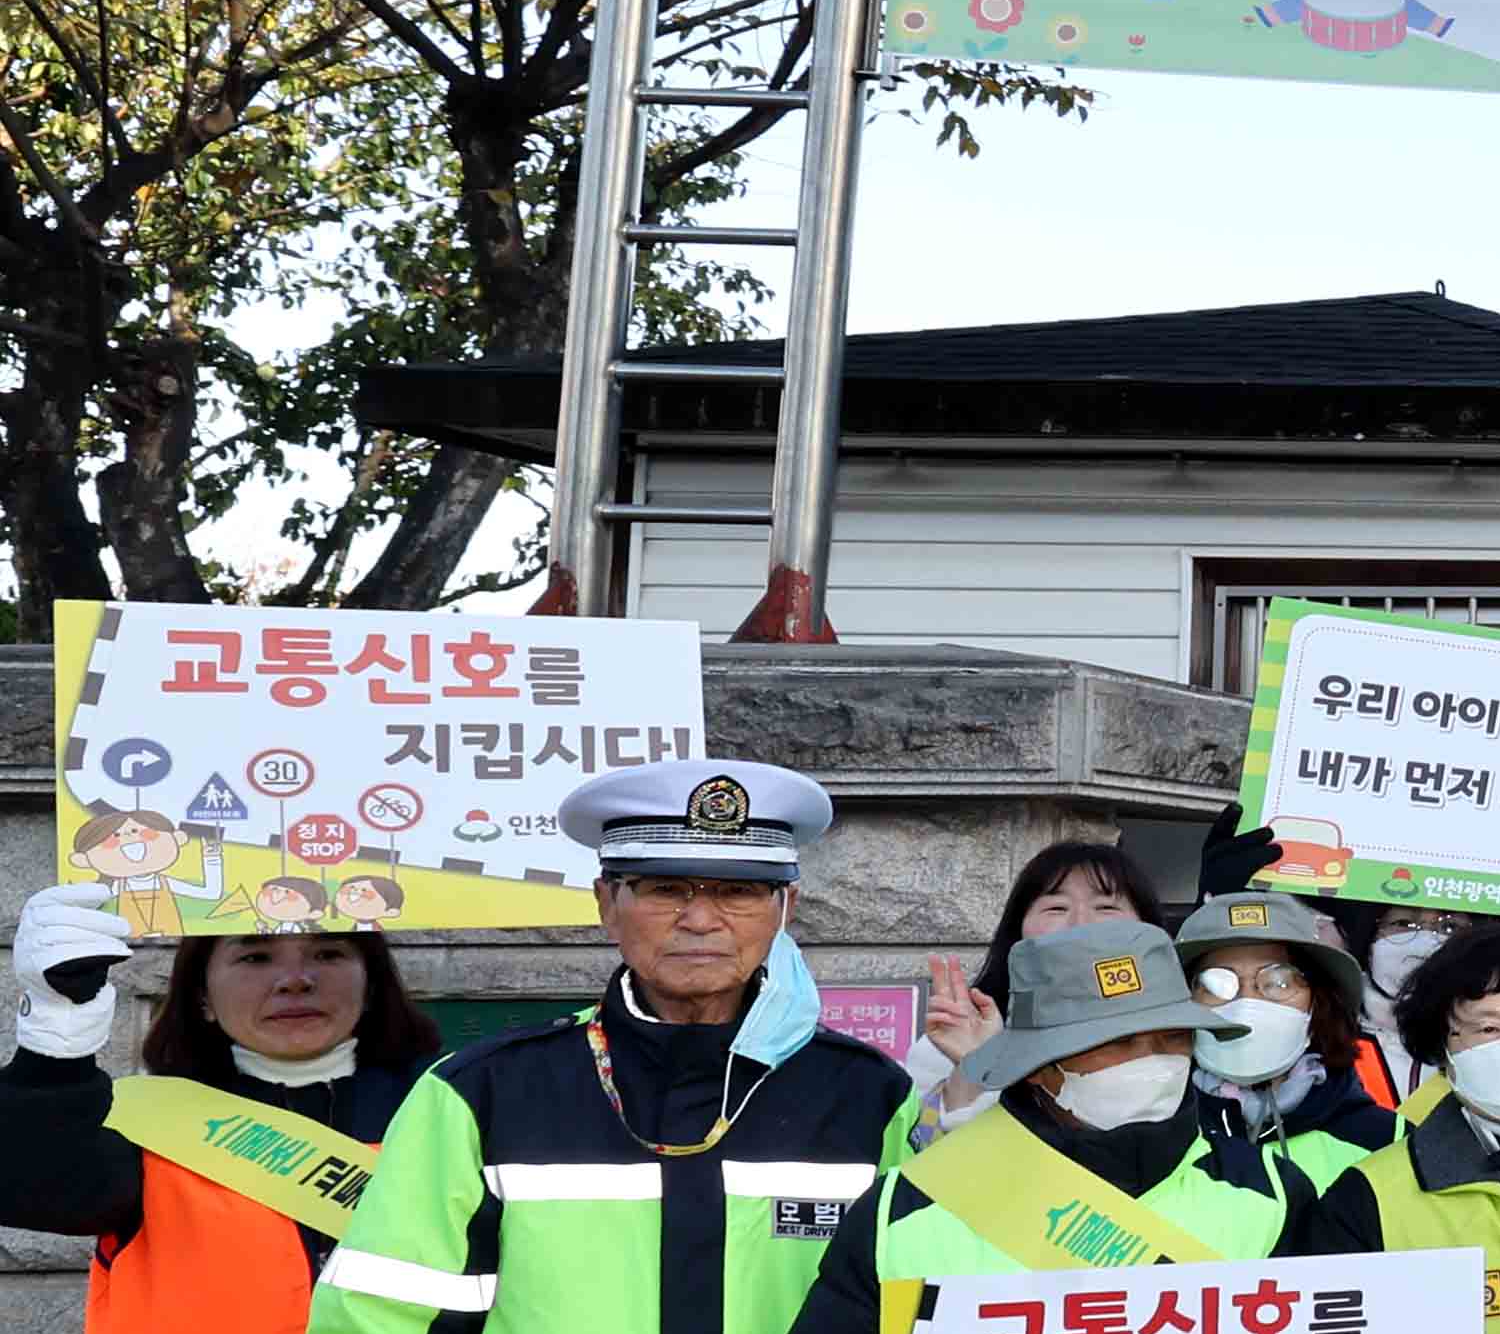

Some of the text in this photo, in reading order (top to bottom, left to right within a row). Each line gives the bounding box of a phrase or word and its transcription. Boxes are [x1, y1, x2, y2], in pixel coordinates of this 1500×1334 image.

[161, 628, 585, 708] 교통신호를
[1313, 675, 1399, 723] 우리
[1413, 689, 1500, 736] 아이
[264, 761, 297, 781] 30
[1298, 750, 1391, 795] 내가
[1404, 763, 1491, 807] 먼저
[298, 823, 344, 839] 정지
[302, 843, 344, 857] STOP
